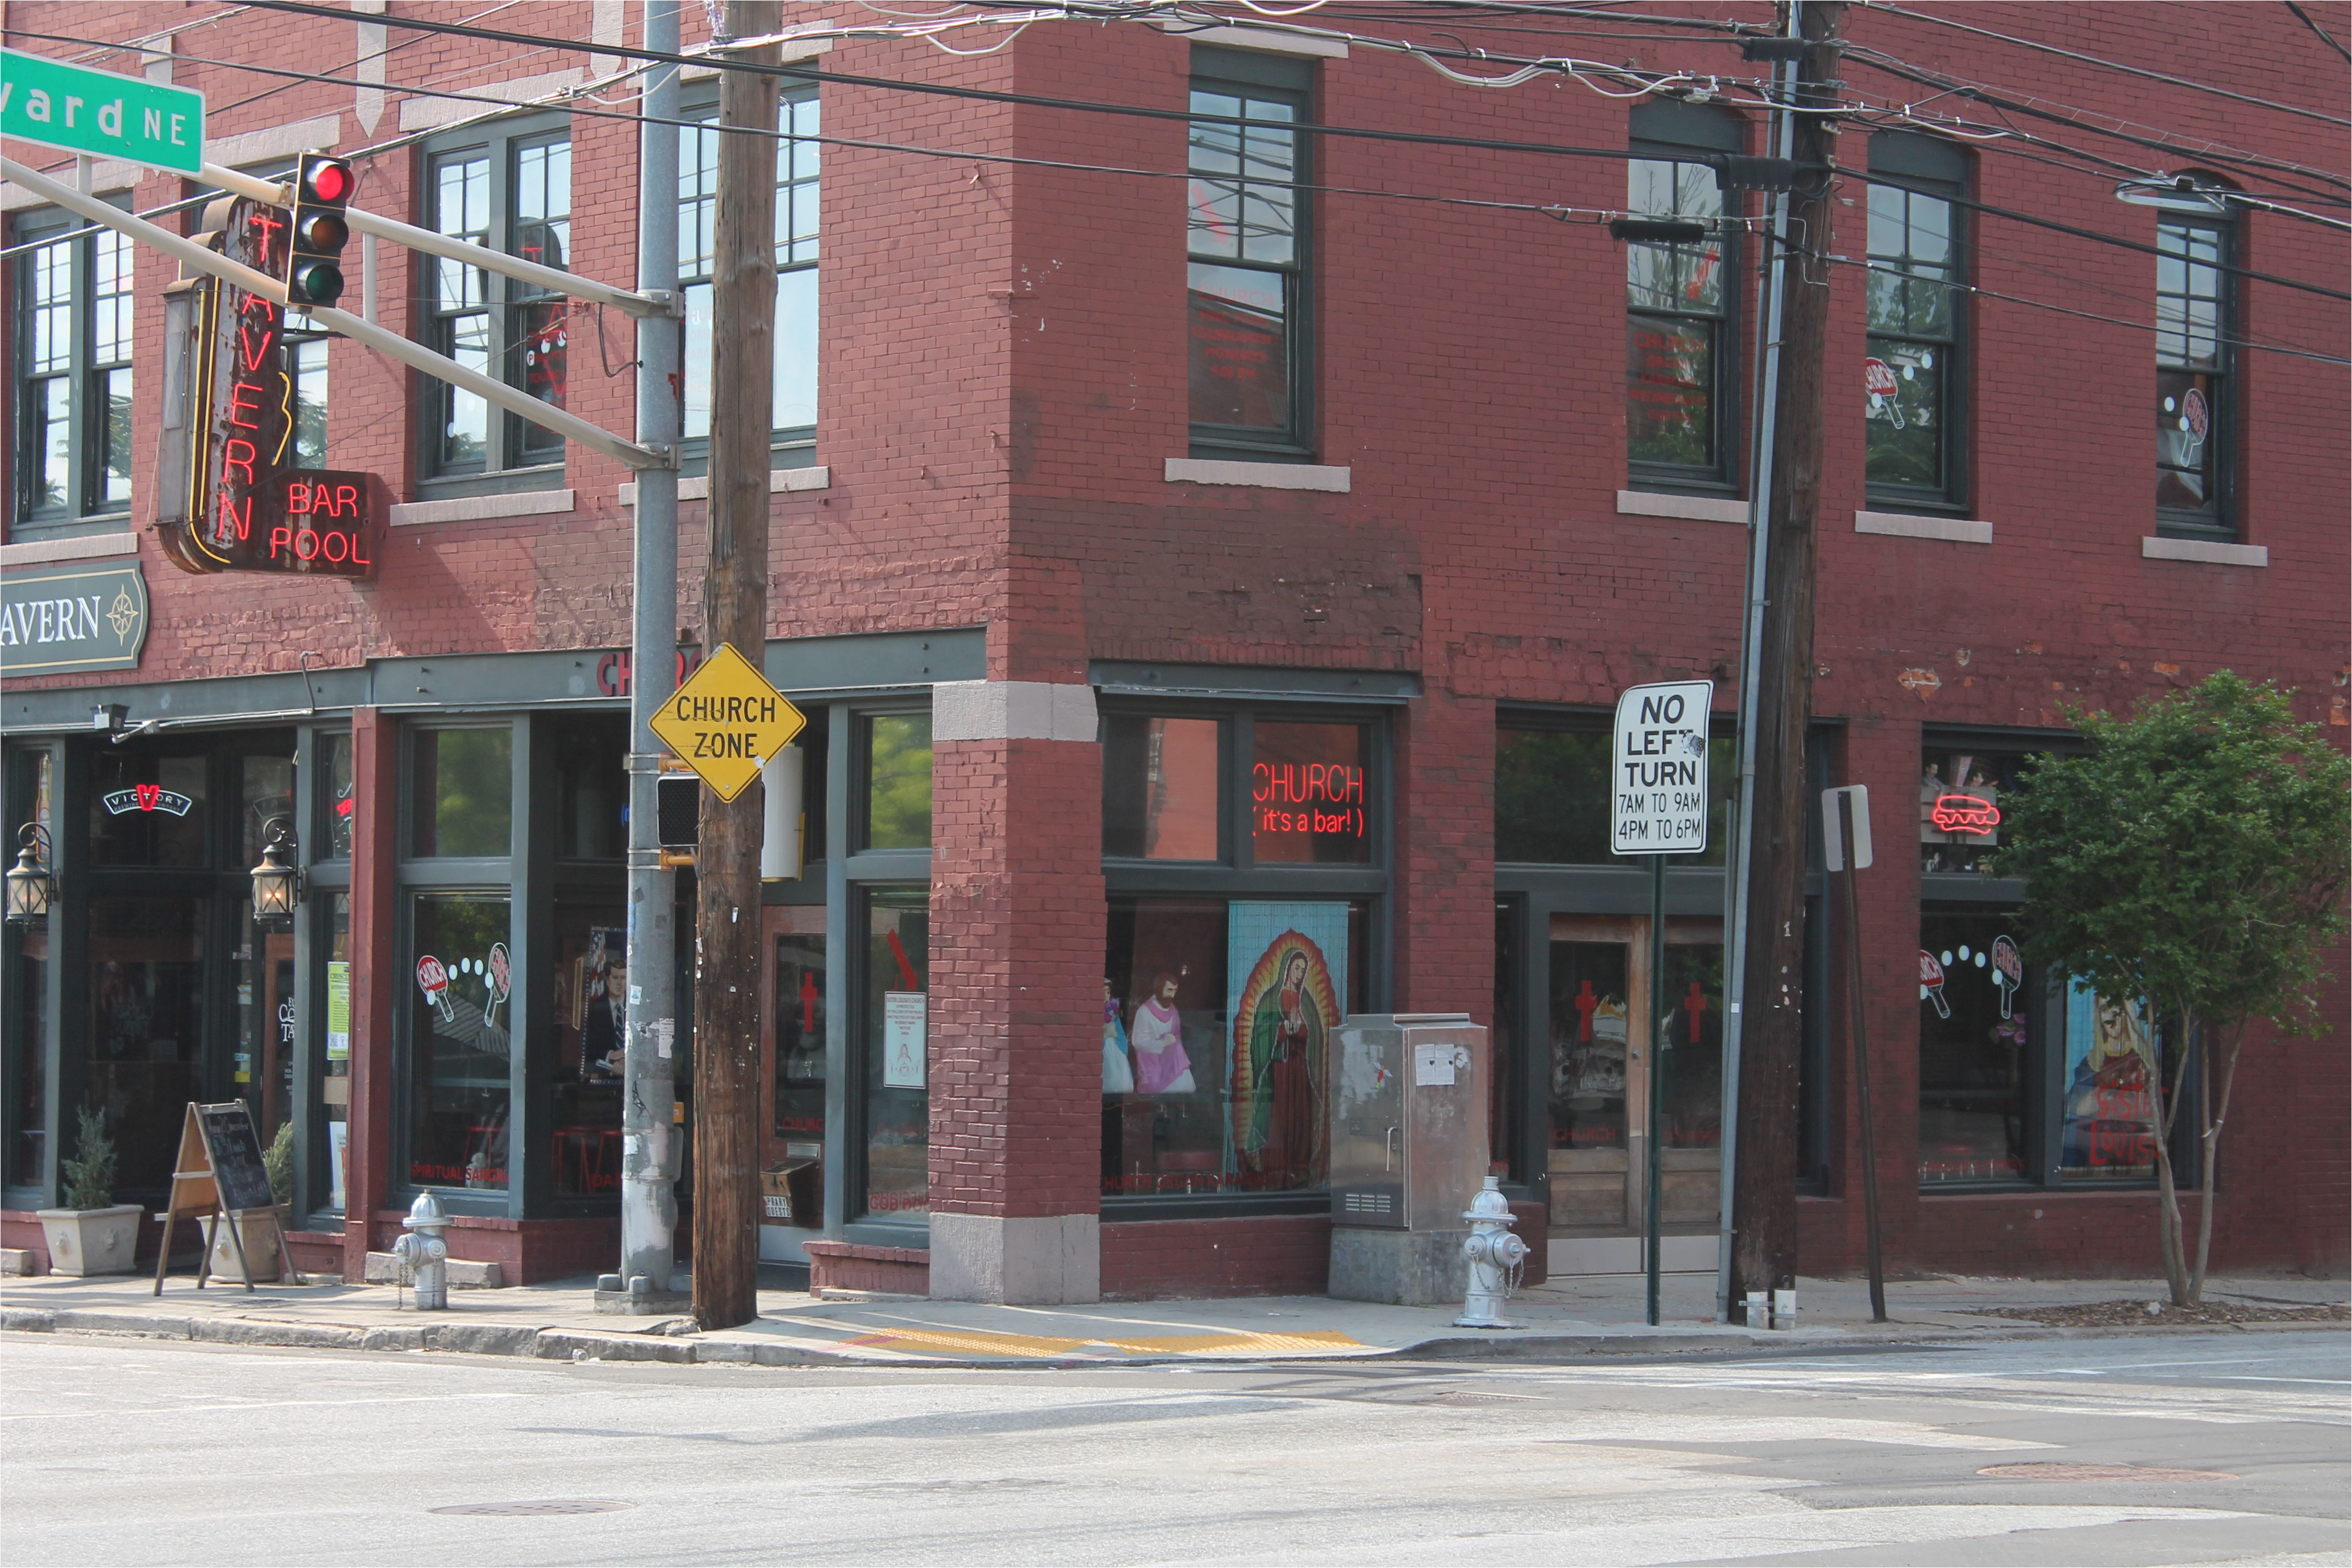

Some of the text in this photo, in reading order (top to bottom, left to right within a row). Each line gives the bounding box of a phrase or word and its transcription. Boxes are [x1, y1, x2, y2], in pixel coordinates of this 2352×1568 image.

[144, 106, 187, 146] NE
[1634, 332, 1704, 352] CHURCH
[216, 216, 283, 541] TAVERN
[288, 482, 358, 518] BAR
[270, 526, 371, 564] POOL
[0, 595, 101, 646] AVERN
[677, 695, 776, 723] CHURCH
[1640, 694, 1685, 724] NO
[694, 732, 759, 758] ZONE
[1252, 763, 1364, 804] CHURCH
[1625, 760, 1696, 787] TURN
[111, 792, 183, 806] VICTORY
[1619, 793, 1701, 814] 7AM TO 9AM
[1297, 815, 1308, 831] a
[1619, 819, 1701, 840] 4PM TO 6PM
[419, 961, 447, 987] CHURCH
[1920, 956, 1942, 981] URCH
[410, 1162, 464, 1180] SPIRITUAL
